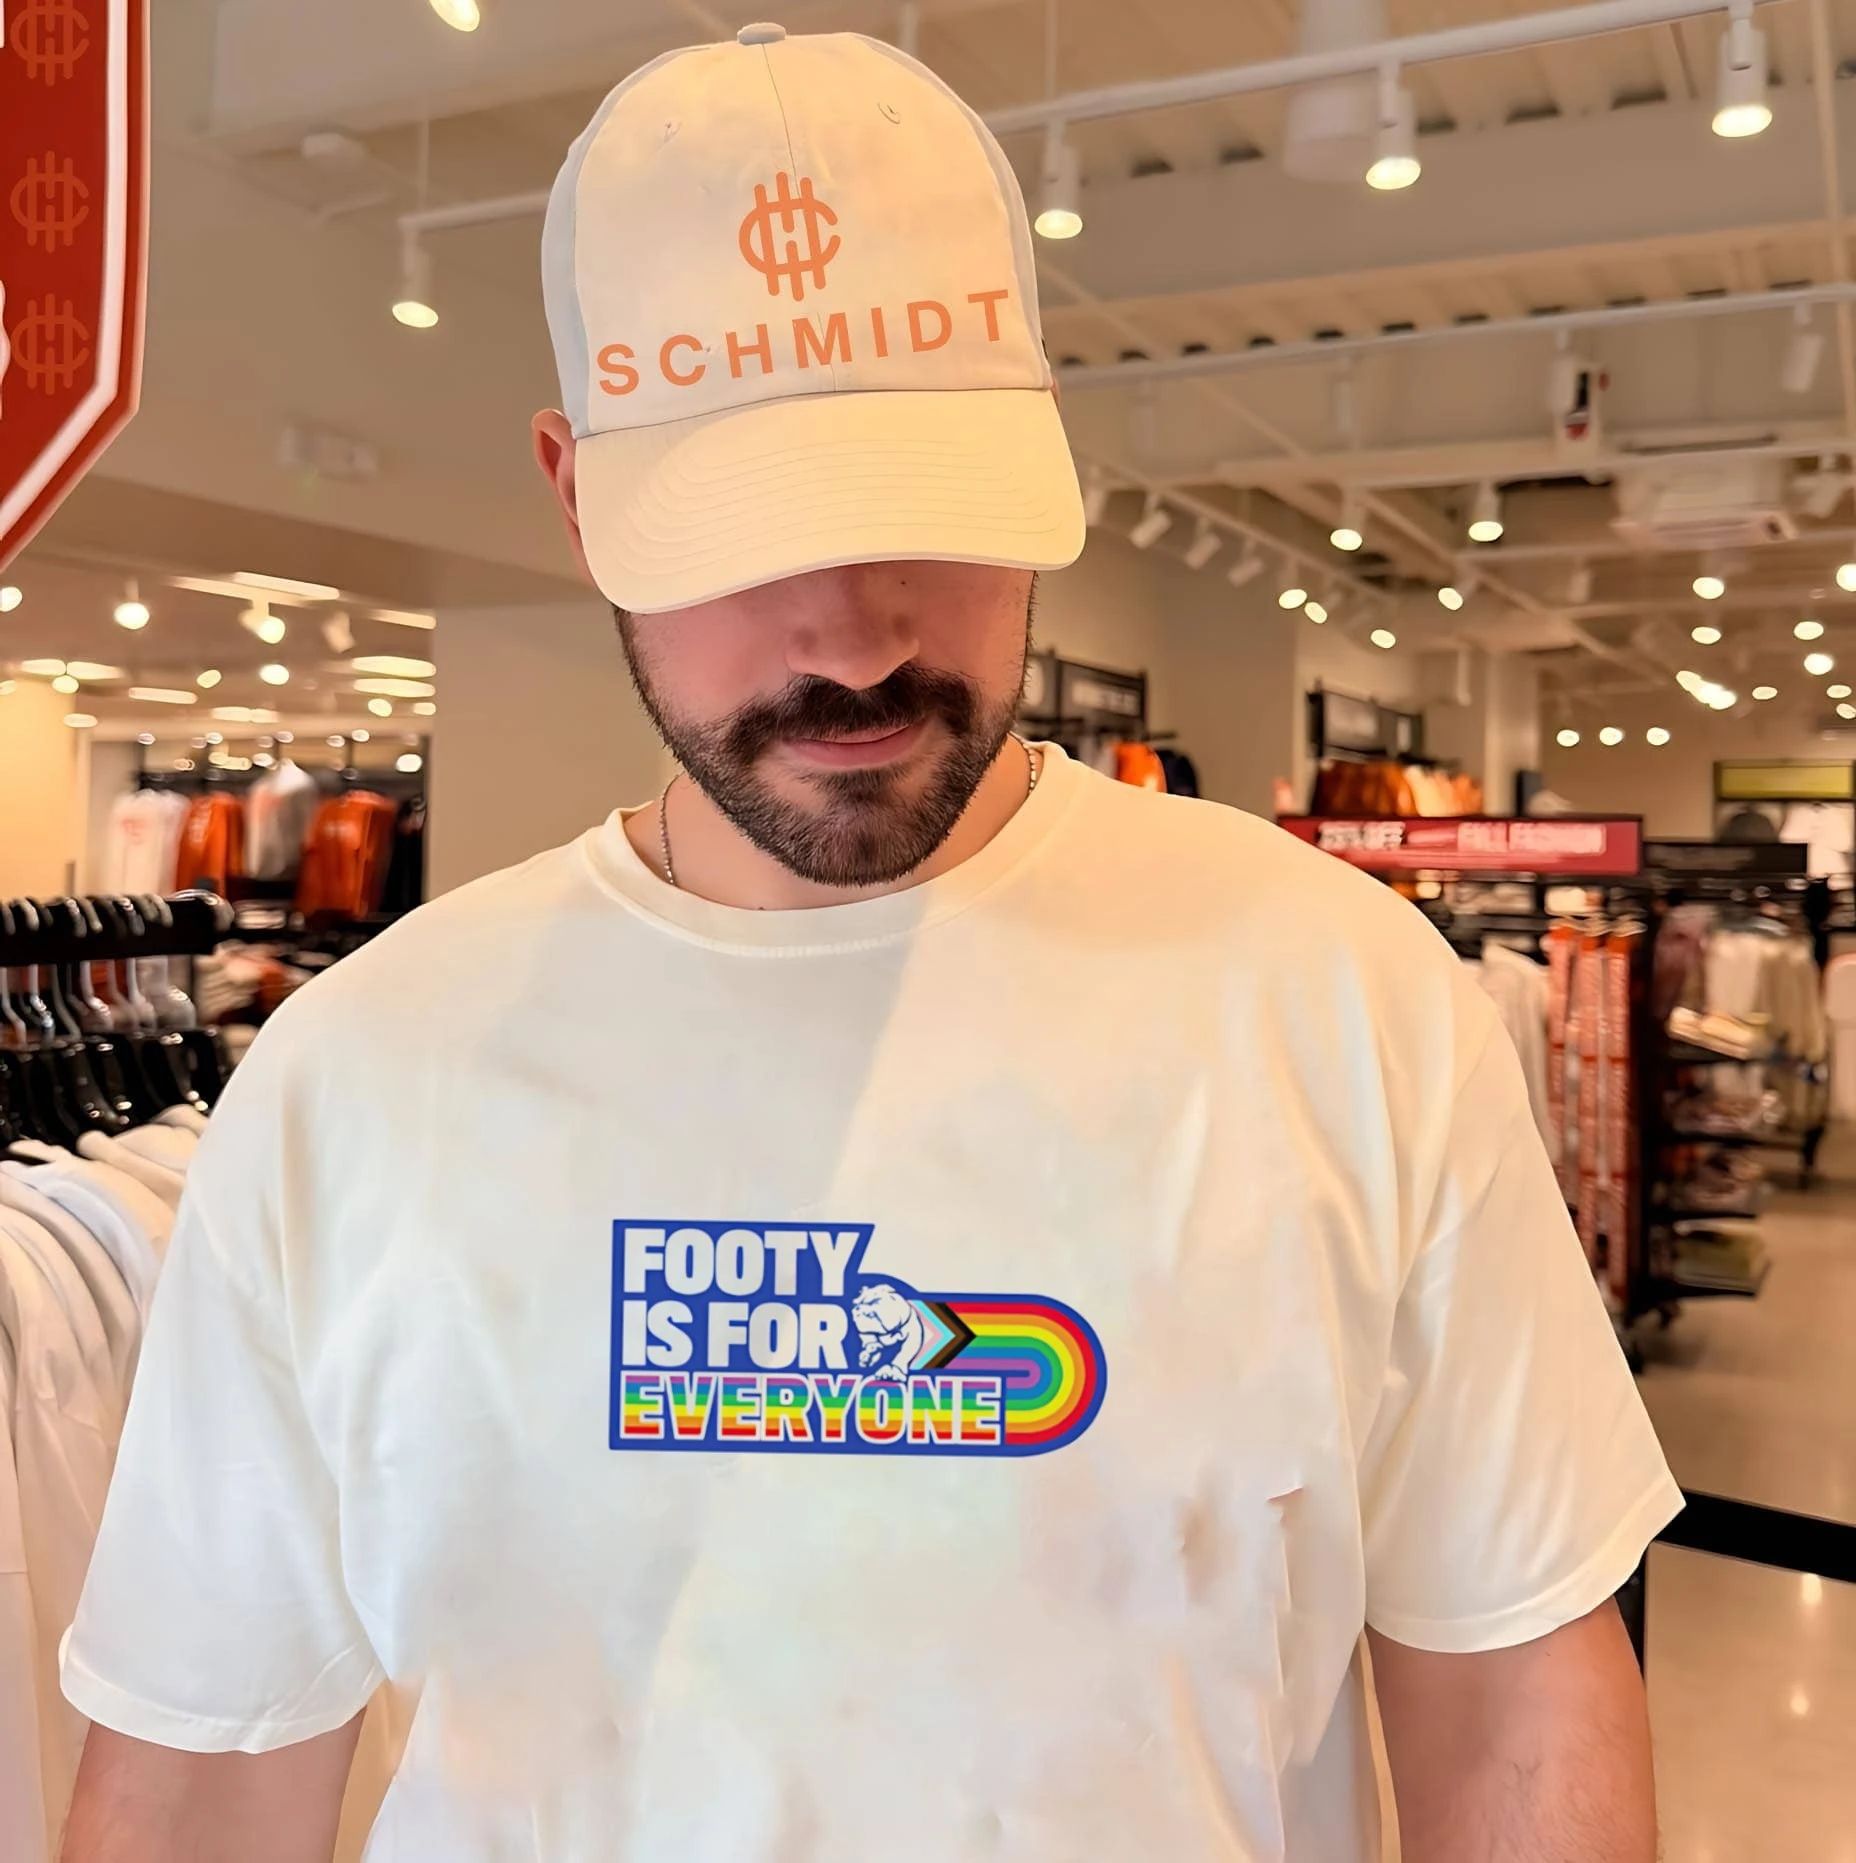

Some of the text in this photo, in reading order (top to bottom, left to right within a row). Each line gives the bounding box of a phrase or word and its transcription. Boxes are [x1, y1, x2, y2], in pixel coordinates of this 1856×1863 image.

[596, 288, 1009, 396] SCHMIDT
[622, 1227, 860, 1297] FOOTY
[622, 1300, 849, 1370] IS FOR
[619, 1370, 1002, 1446] EVERYONE
